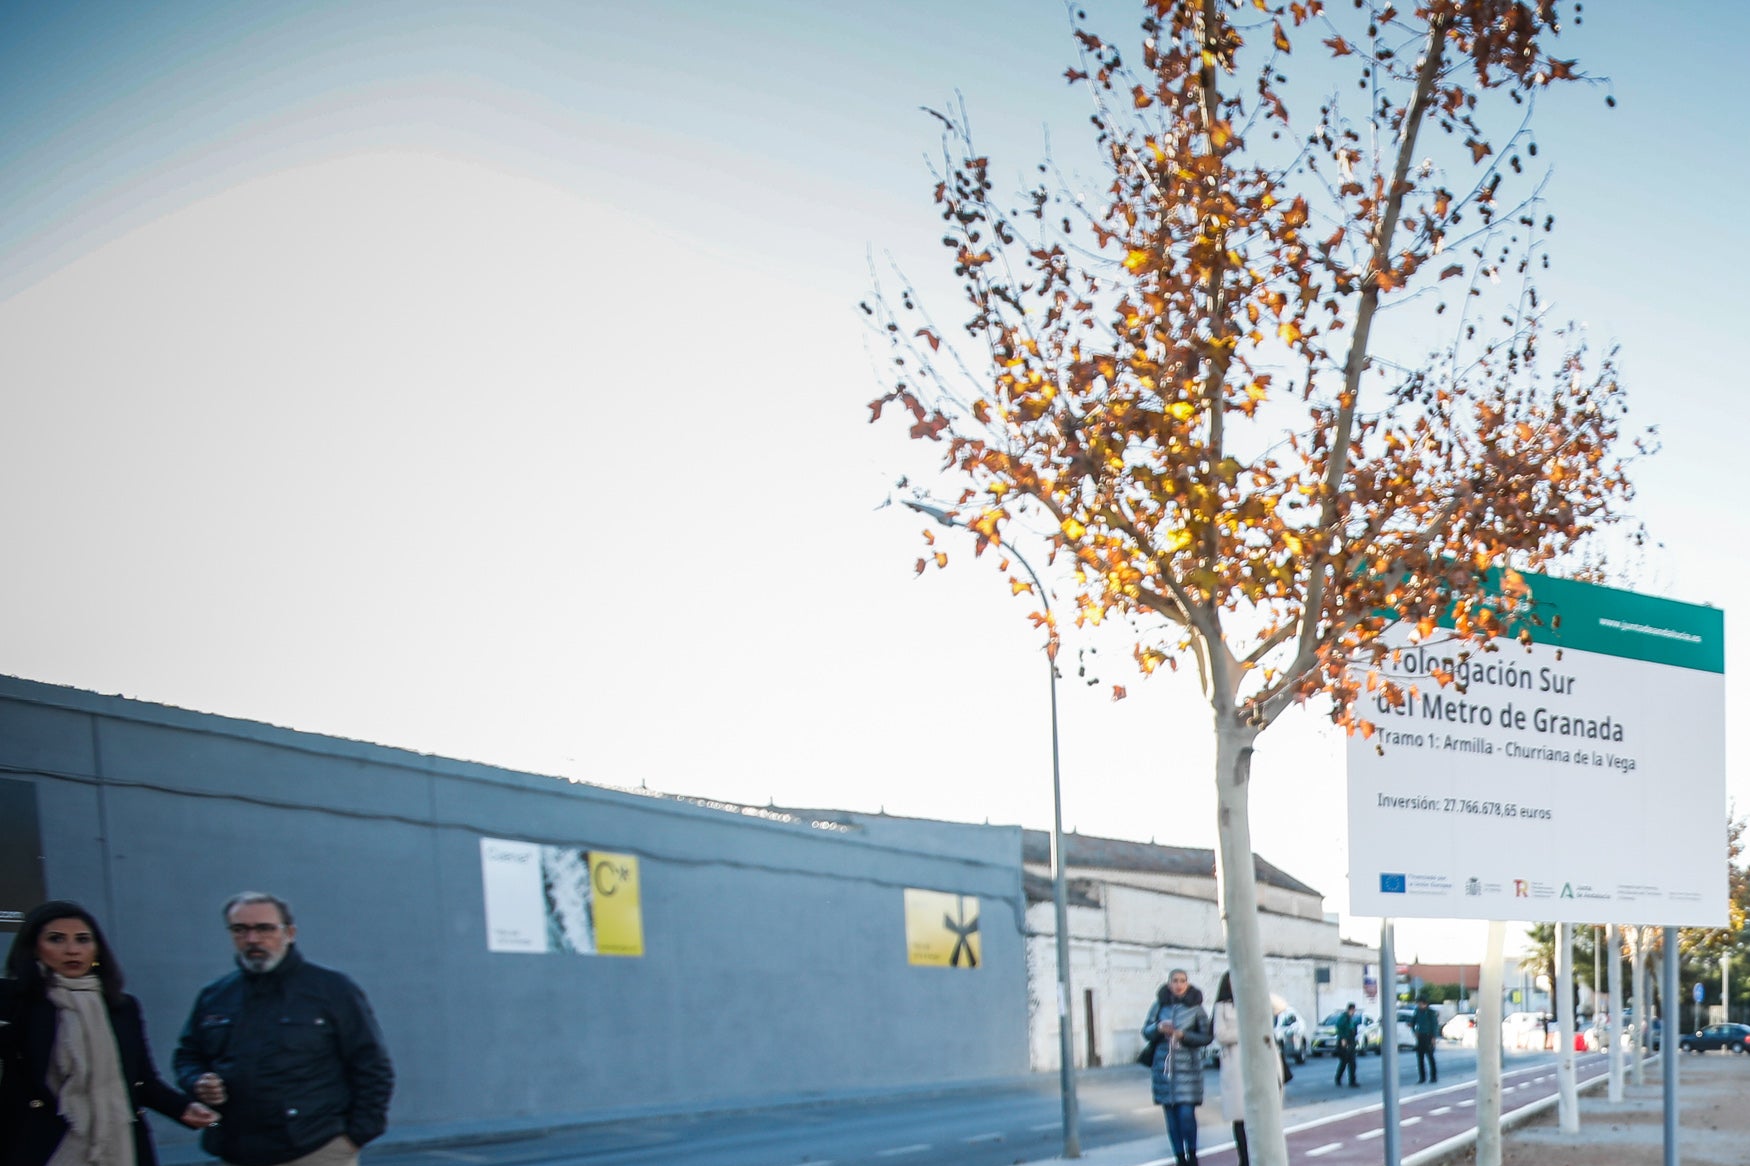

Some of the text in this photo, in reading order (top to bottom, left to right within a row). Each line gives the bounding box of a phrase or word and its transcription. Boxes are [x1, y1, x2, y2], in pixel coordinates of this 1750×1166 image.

[1388, 646, 1576, 696] olongación Sur
[1422, 692, 1493, 726] Metro
[1500, 702, 1526, 731] de
[1534, 707, 1624, 743] Granada
[1377, 726, 1424, 747] Tramo
[1429, 732, 1440, 749] 1:
[1443, 734, 1494, 755] Armilla
[1505, 741, 1570, 763] Churriana
[1574, 748, 1589, 766] de
[1592, 750, 1603, 767] la
[1607, 753, 1636, 773] Vega
[1377, 793, 1440, 811] Inversión:
[1520, 806, 1552, 820] euros
